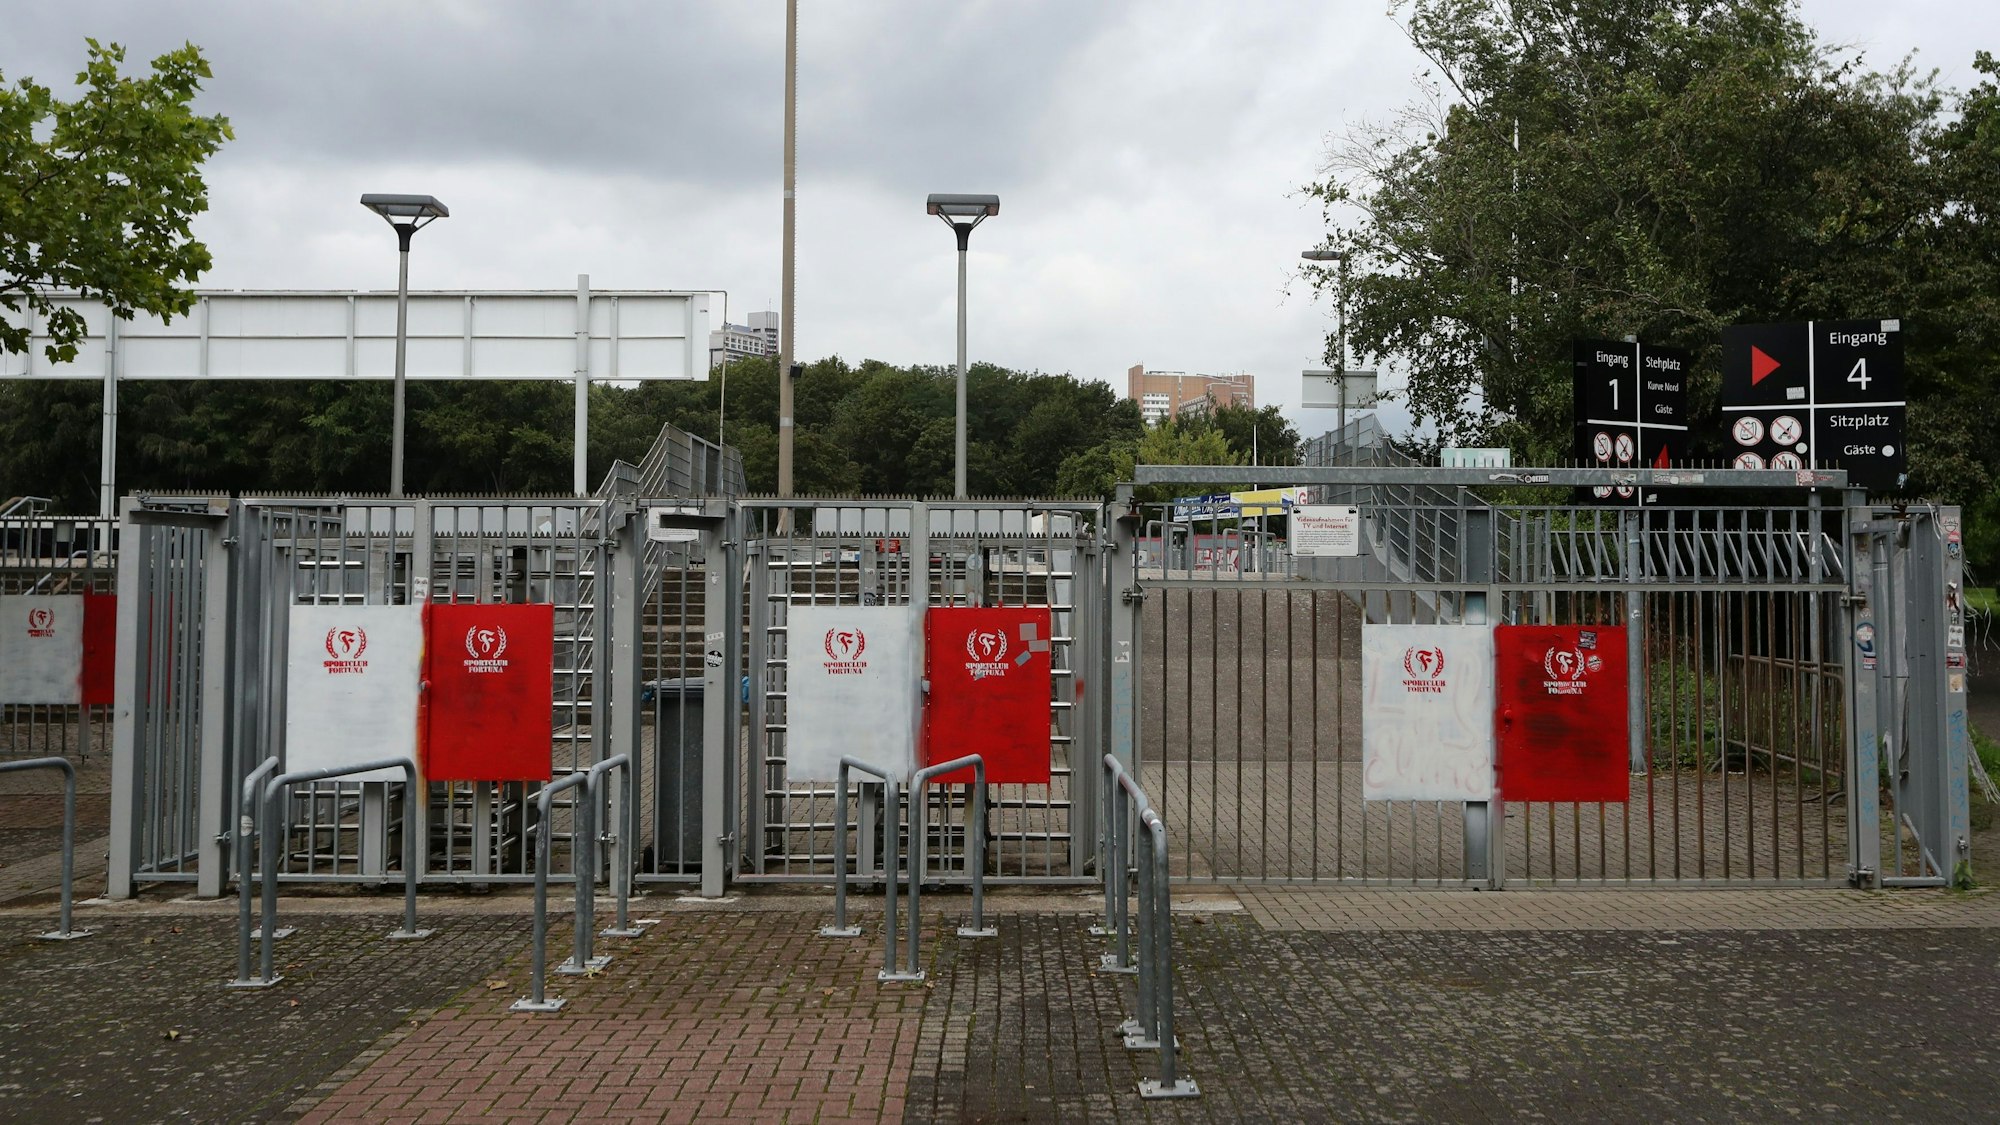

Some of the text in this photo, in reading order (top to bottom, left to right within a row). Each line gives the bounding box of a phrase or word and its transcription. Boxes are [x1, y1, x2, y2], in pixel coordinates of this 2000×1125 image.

[1829, 332, 1887, 347] Eingang
[1596, 351, 1629, 368] Eingang
[1645, 356, 1681, 372] Stehplatz
[1847, 357, 1872, 391] 4
[1608, 378, 1619, 410] 1
[1647, 381, 1679, 392] Kurve Nord
[1655, 404, 1673, 414] Gäste
[1830, 414, 1889, 430] Sitzplatz
[1843, 445, 1876, 455] Gäste
[463, 659, 508, 667] SPORTCLUB
[1402, 679, 1446, 687] SPORTCLUB
